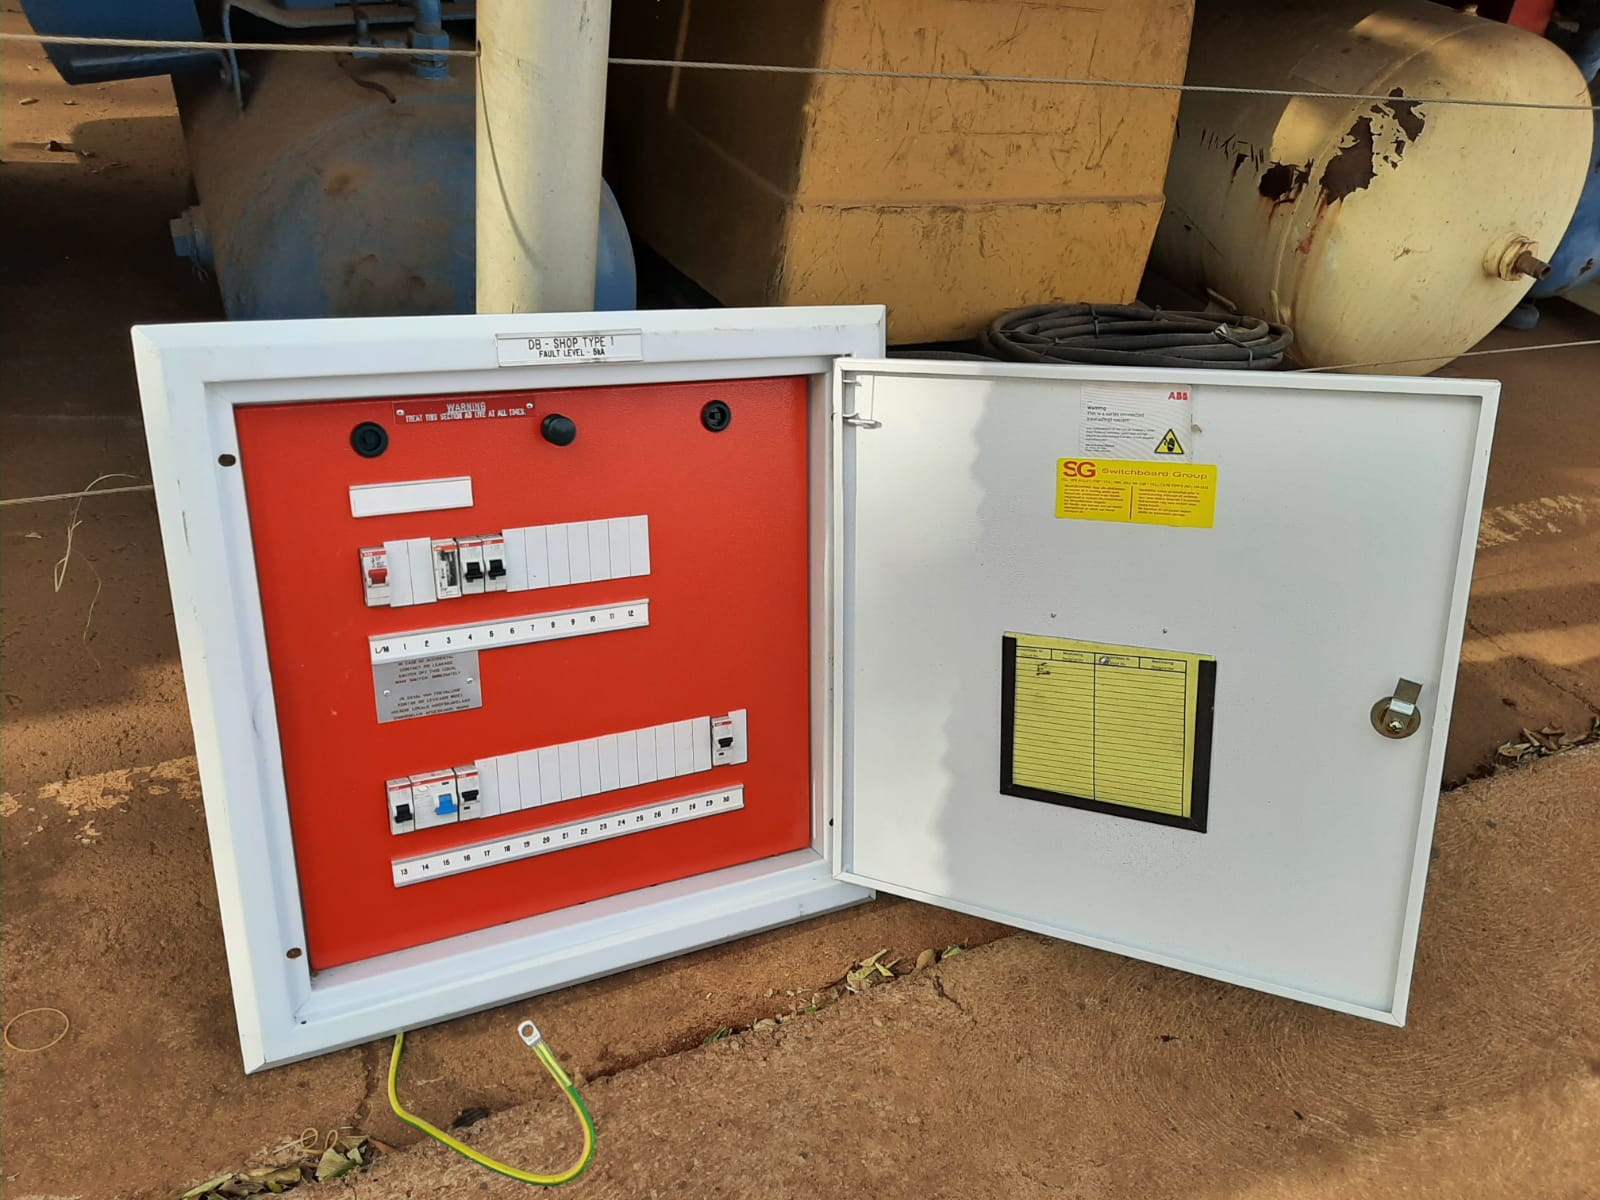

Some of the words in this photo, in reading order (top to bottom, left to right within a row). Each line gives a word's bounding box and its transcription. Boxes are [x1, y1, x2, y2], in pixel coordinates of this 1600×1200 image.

[528, 339, 542, 350] DB
[554, 337, 578, 349] SHOP
[582, 336, 605, 347] TYPE
[611, 336, 615, 346] 1
[539, 350, 560, 358] FAULT
[564, 349, 585, 357] LEVEL
[1168, 392, 1188, 400] ABB
[446, 402, 486, 413] WARNING
[497, 409, 507, 417] ALL
[1063, 461, 1096, 478] SG
[1102, 467, 1168, 477] Switchboard
[1173, 471, 1207, 480] Group
[464, 854, 471, 862] 16
[543, 836, 550, 844] 20
[689, 803, 696, 811] 28
